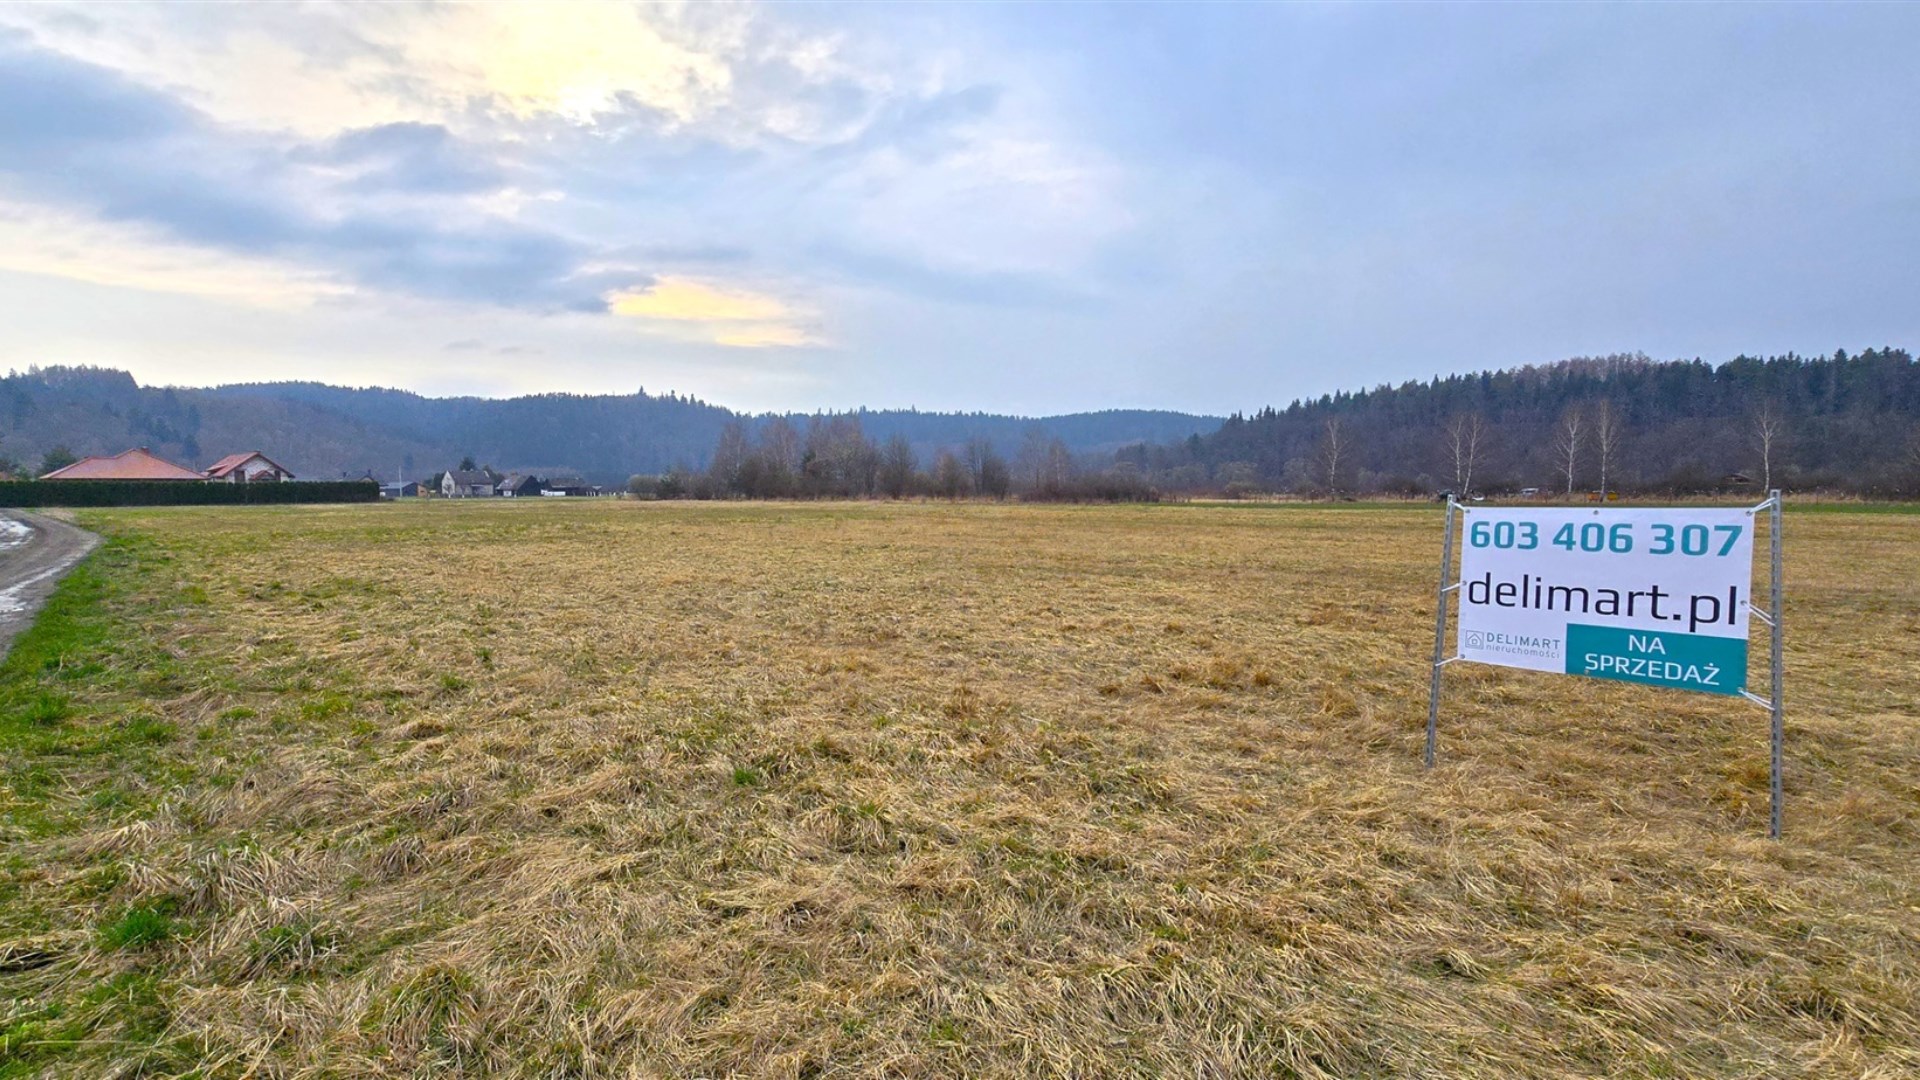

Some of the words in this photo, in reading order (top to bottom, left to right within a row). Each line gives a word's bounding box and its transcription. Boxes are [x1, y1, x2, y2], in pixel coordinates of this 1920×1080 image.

[1470, 520, 1539, 550] 603
[1552, 522, 1633, 554] 406
[1649, 523, 1743, 557] 307
[1468, 572, 1738, 632] delimart.pl
[1486, 632, 1561, 650] DELIMART
[1486, 644, 1561, 659] nieruchomości
[1629, 634, 1667, 655] NA
[1584, 653, 1721, 686] SPRZEDAŻ
